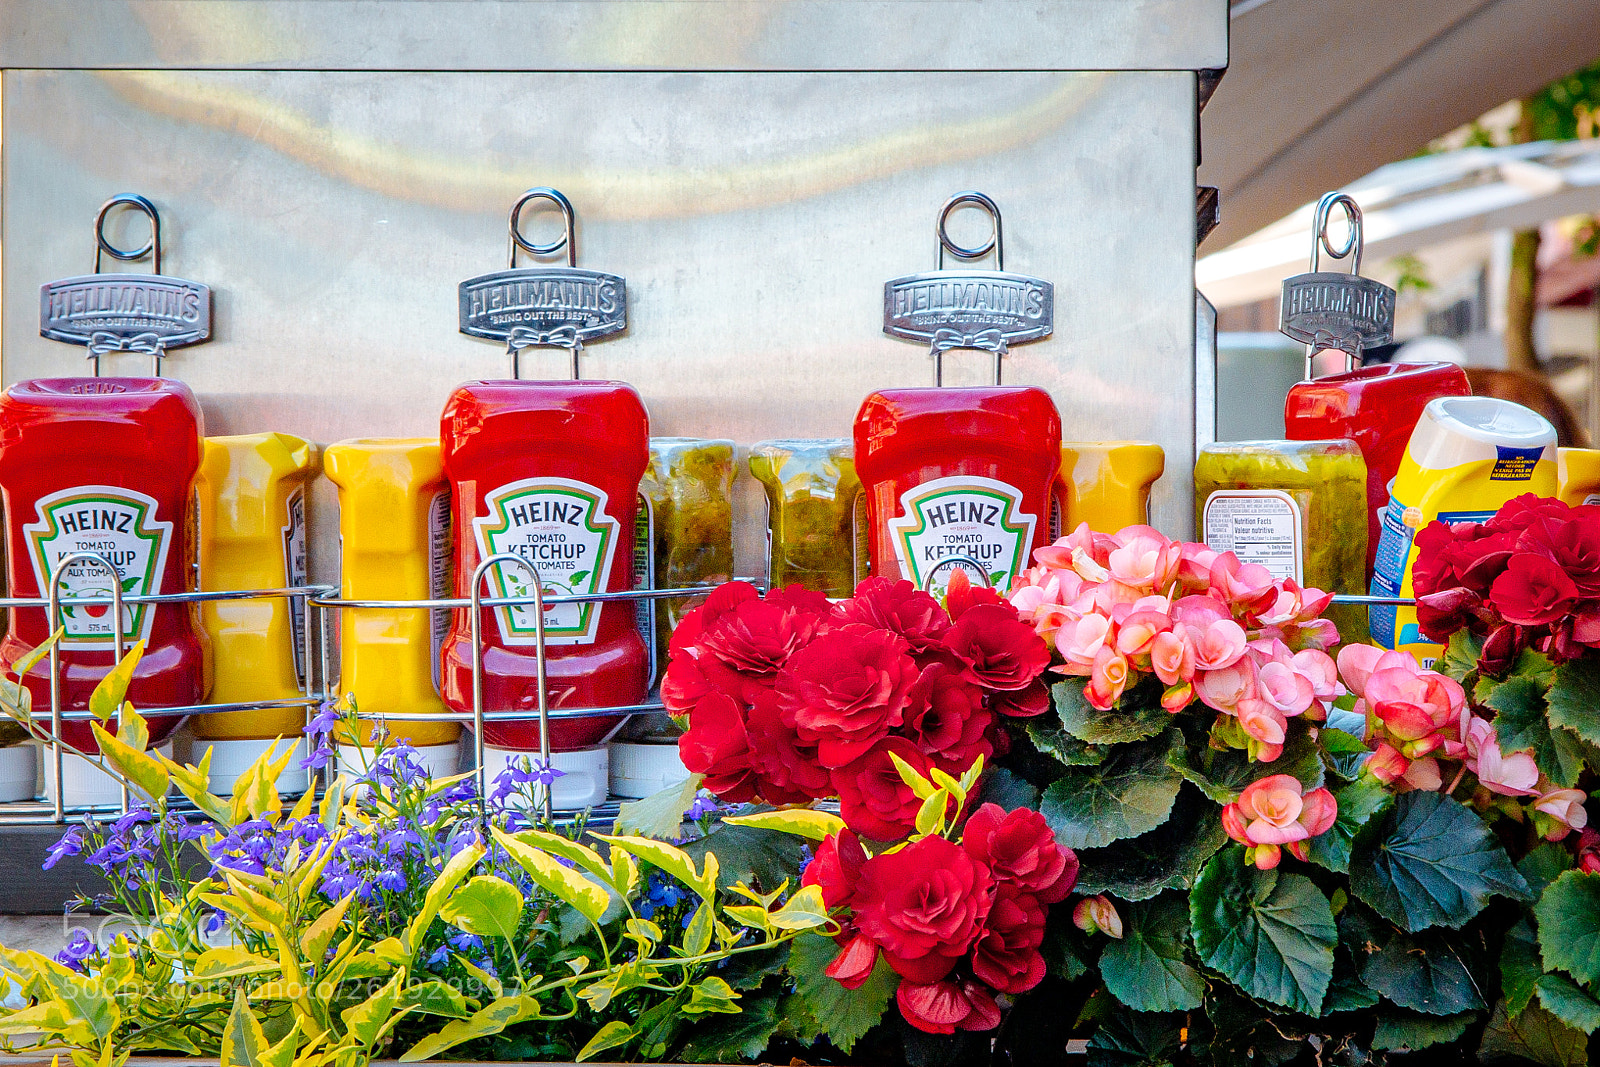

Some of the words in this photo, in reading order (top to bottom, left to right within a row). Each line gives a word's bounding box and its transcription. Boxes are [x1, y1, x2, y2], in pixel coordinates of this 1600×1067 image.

[469, 276, 616, 318] HELLMANN'S
[893, 281, 1044, 319] HELLMANN'S
[50, 285, 200, 322] HELLMANN'S
[523, 312, 545, 320] OUT
[546, 312, 565, 320] THE
[949, 314, 971, 323] OUT
[972, 314, 991, 323] THE
[106, 318, 128, 326] OUT
[130, 318, 148, 327] THE
[510, 501, 584, 527] HEINZ
[926, 502, 1000, 528] HEINZ
[59, 509, 133, 535] HEINZ
[526, 534, 566, 543] TOMATO
[943, 534, 983, 543] TOMATO
[75, 541, 116, 550] TOMATO
[536, 561, 575, 570] TOMATES
[67, 569, 84, 577] AUX
[86, 568, 126, 577] TOMAES
